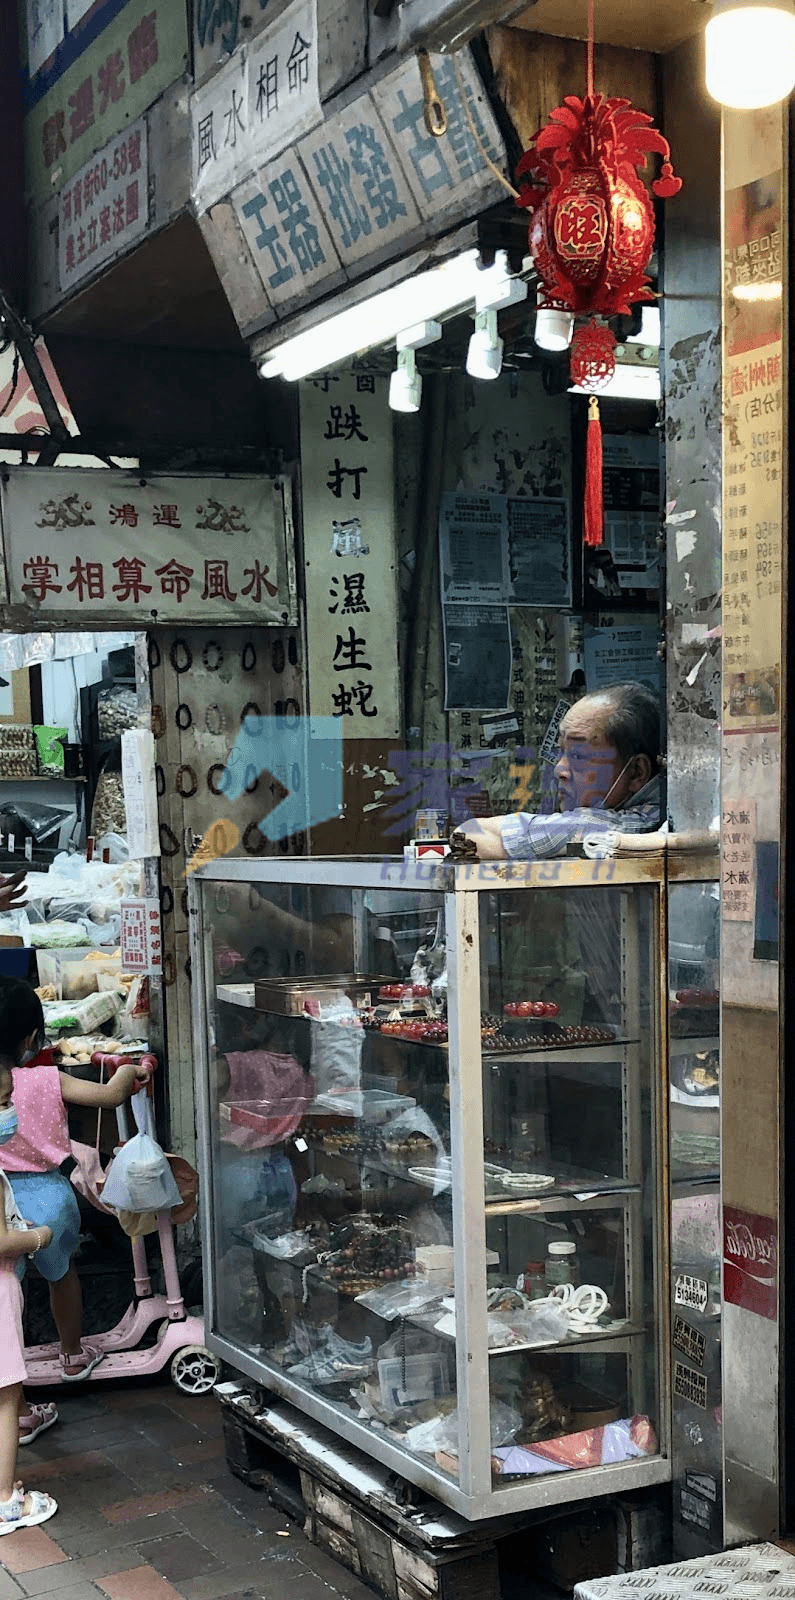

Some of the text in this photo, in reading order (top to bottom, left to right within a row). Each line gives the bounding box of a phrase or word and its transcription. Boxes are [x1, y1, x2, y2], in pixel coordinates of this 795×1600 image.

[40, 9, 159, 168] 歡迎光臨
[197, 31, 312, 172] 風水相命
[108, 503, 182, 528] 鴻運
[21, 555, 279, 603] 掌相算命風水
